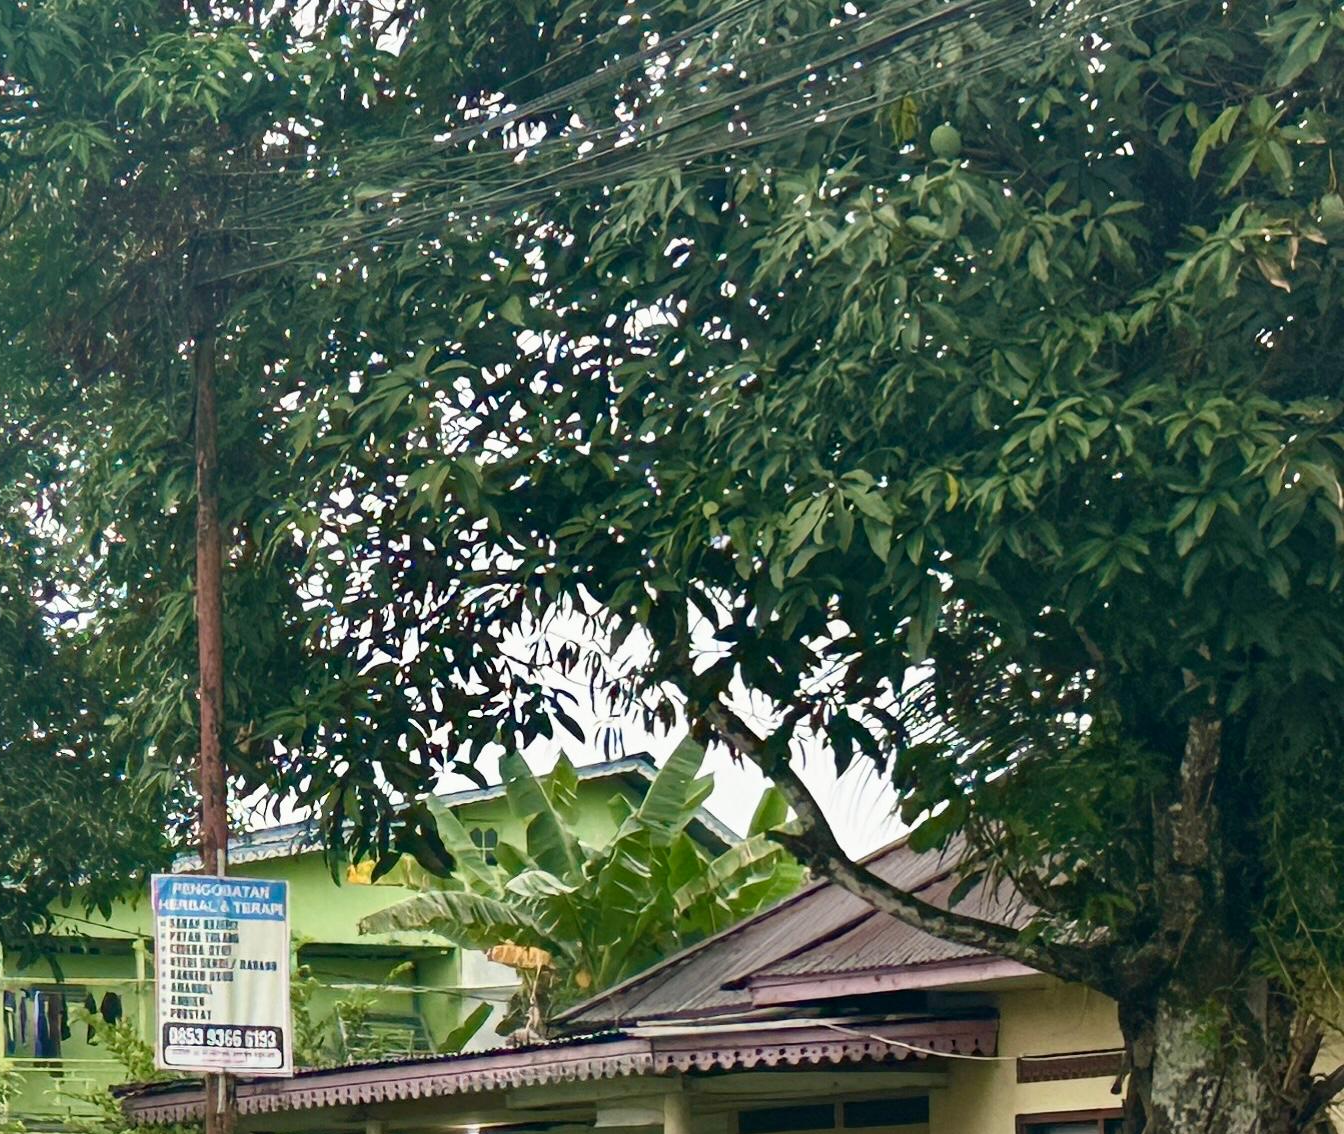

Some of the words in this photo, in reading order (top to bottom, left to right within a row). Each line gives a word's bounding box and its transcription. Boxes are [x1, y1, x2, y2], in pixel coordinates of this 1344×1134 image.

[173, 882, 270, 899] PENGOBATAN
[159, 898, 218, 912] HERBAL
[233, 902, 284, 916] TERAPI
[169, 1026, 204, 1045] 0853
[206, 1028, 242, 1047] 9366
[245, 1030, 277, 1048] 6193
